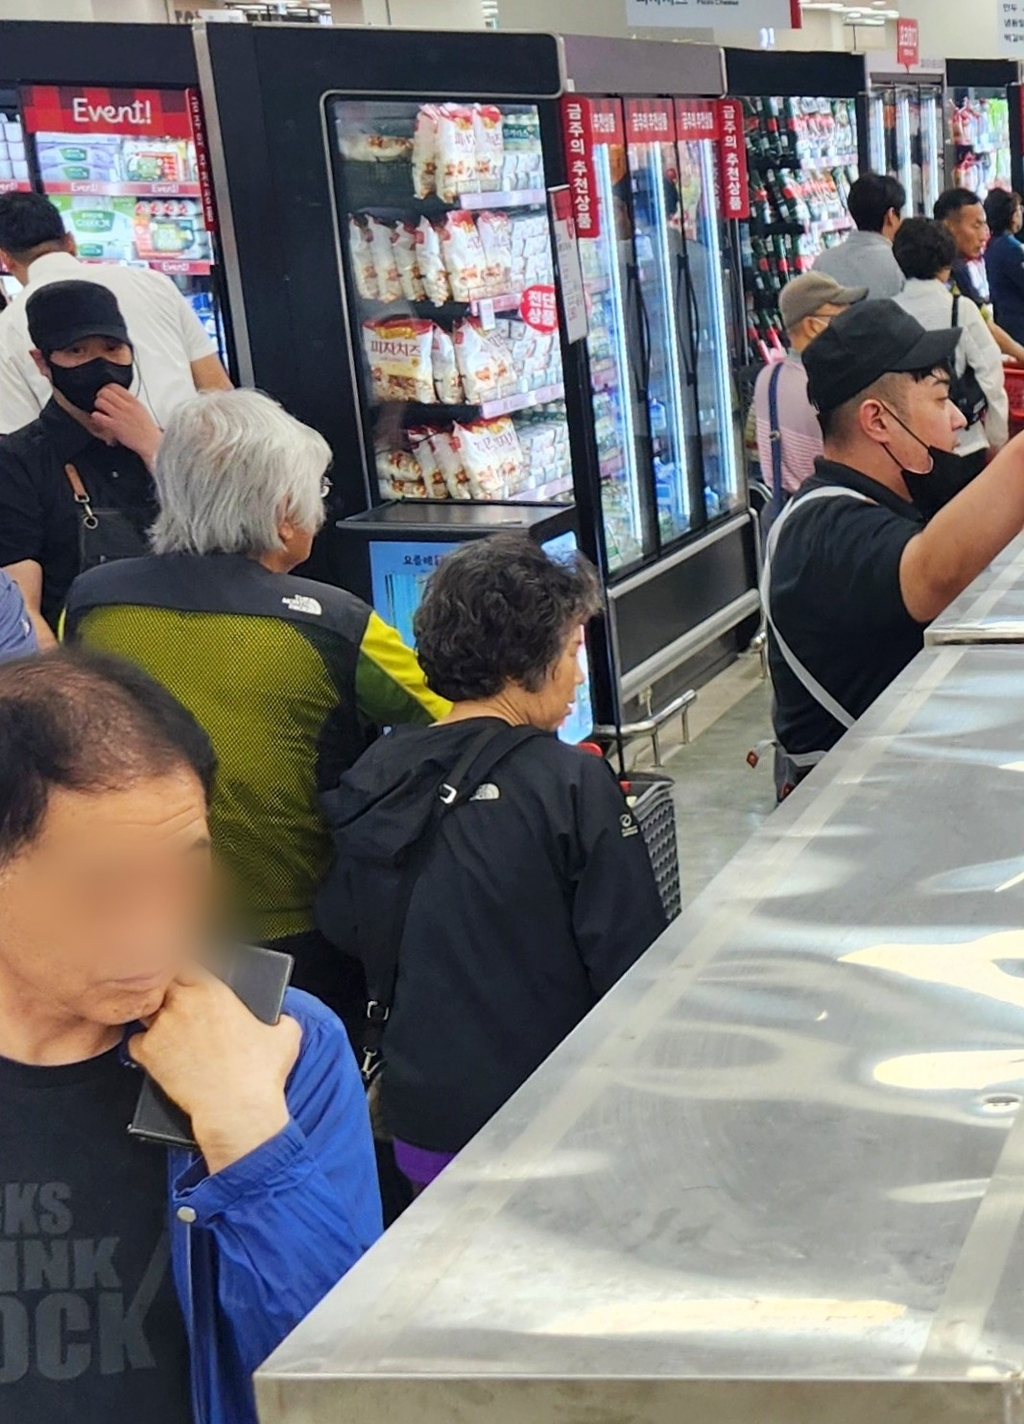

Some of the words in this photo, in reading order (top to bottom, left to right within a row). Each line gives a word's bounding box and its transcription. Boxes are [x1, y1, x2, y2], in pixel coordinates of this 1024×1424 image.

[72, 97, 152, 124] Event!
[567, 103, 585, 155] 금주의
[723, 105, 737, 149] 금주의
[71, 183, 98, 192] Event!
[152, 184, 180, 193] Event!
[572, 160, 592, 229] 추천상품
[726, 153, 742, 211] 추천상품
[162, 261, 189, 273] Event!
[371, 340, 422, 357] 피자치즈
